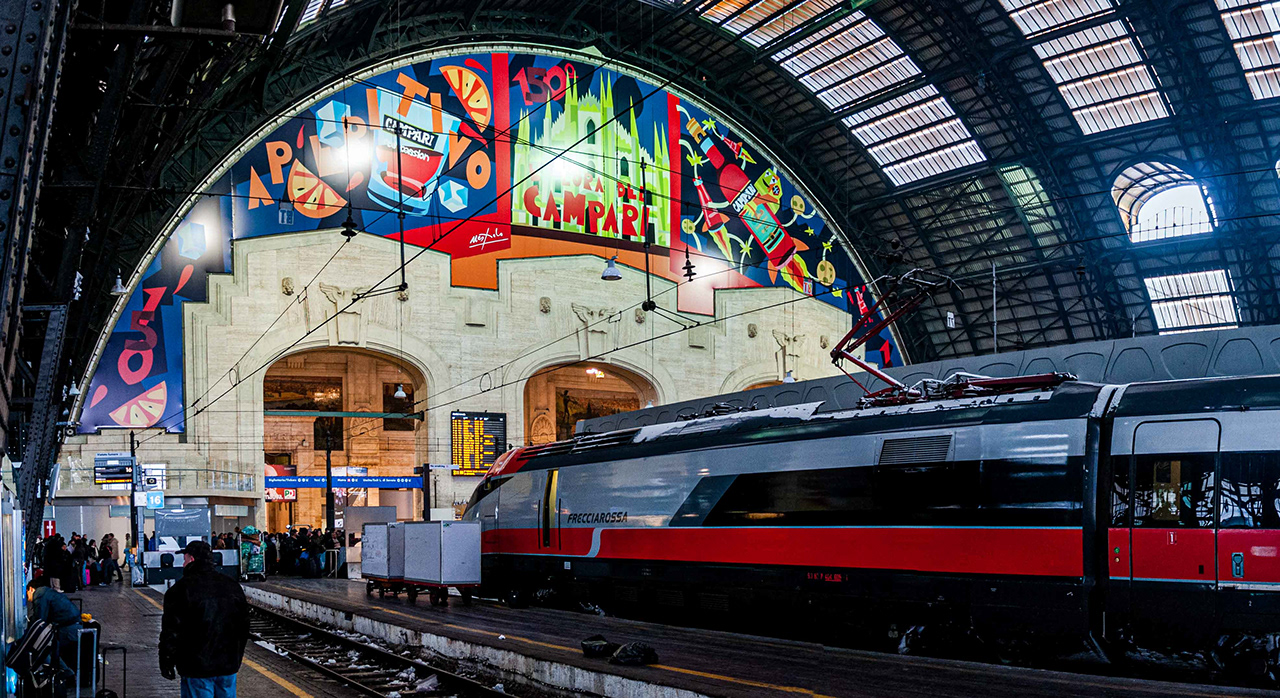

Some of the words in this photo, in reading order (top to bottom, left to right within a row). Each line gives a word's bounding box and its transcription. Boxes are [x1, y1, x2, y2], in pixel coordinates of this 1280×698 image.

[523, 184, 650, 238] CAMPARI
[150, 496, 161, 505] 16
[567, 511, 628, 524] FRECCIAROSSA
